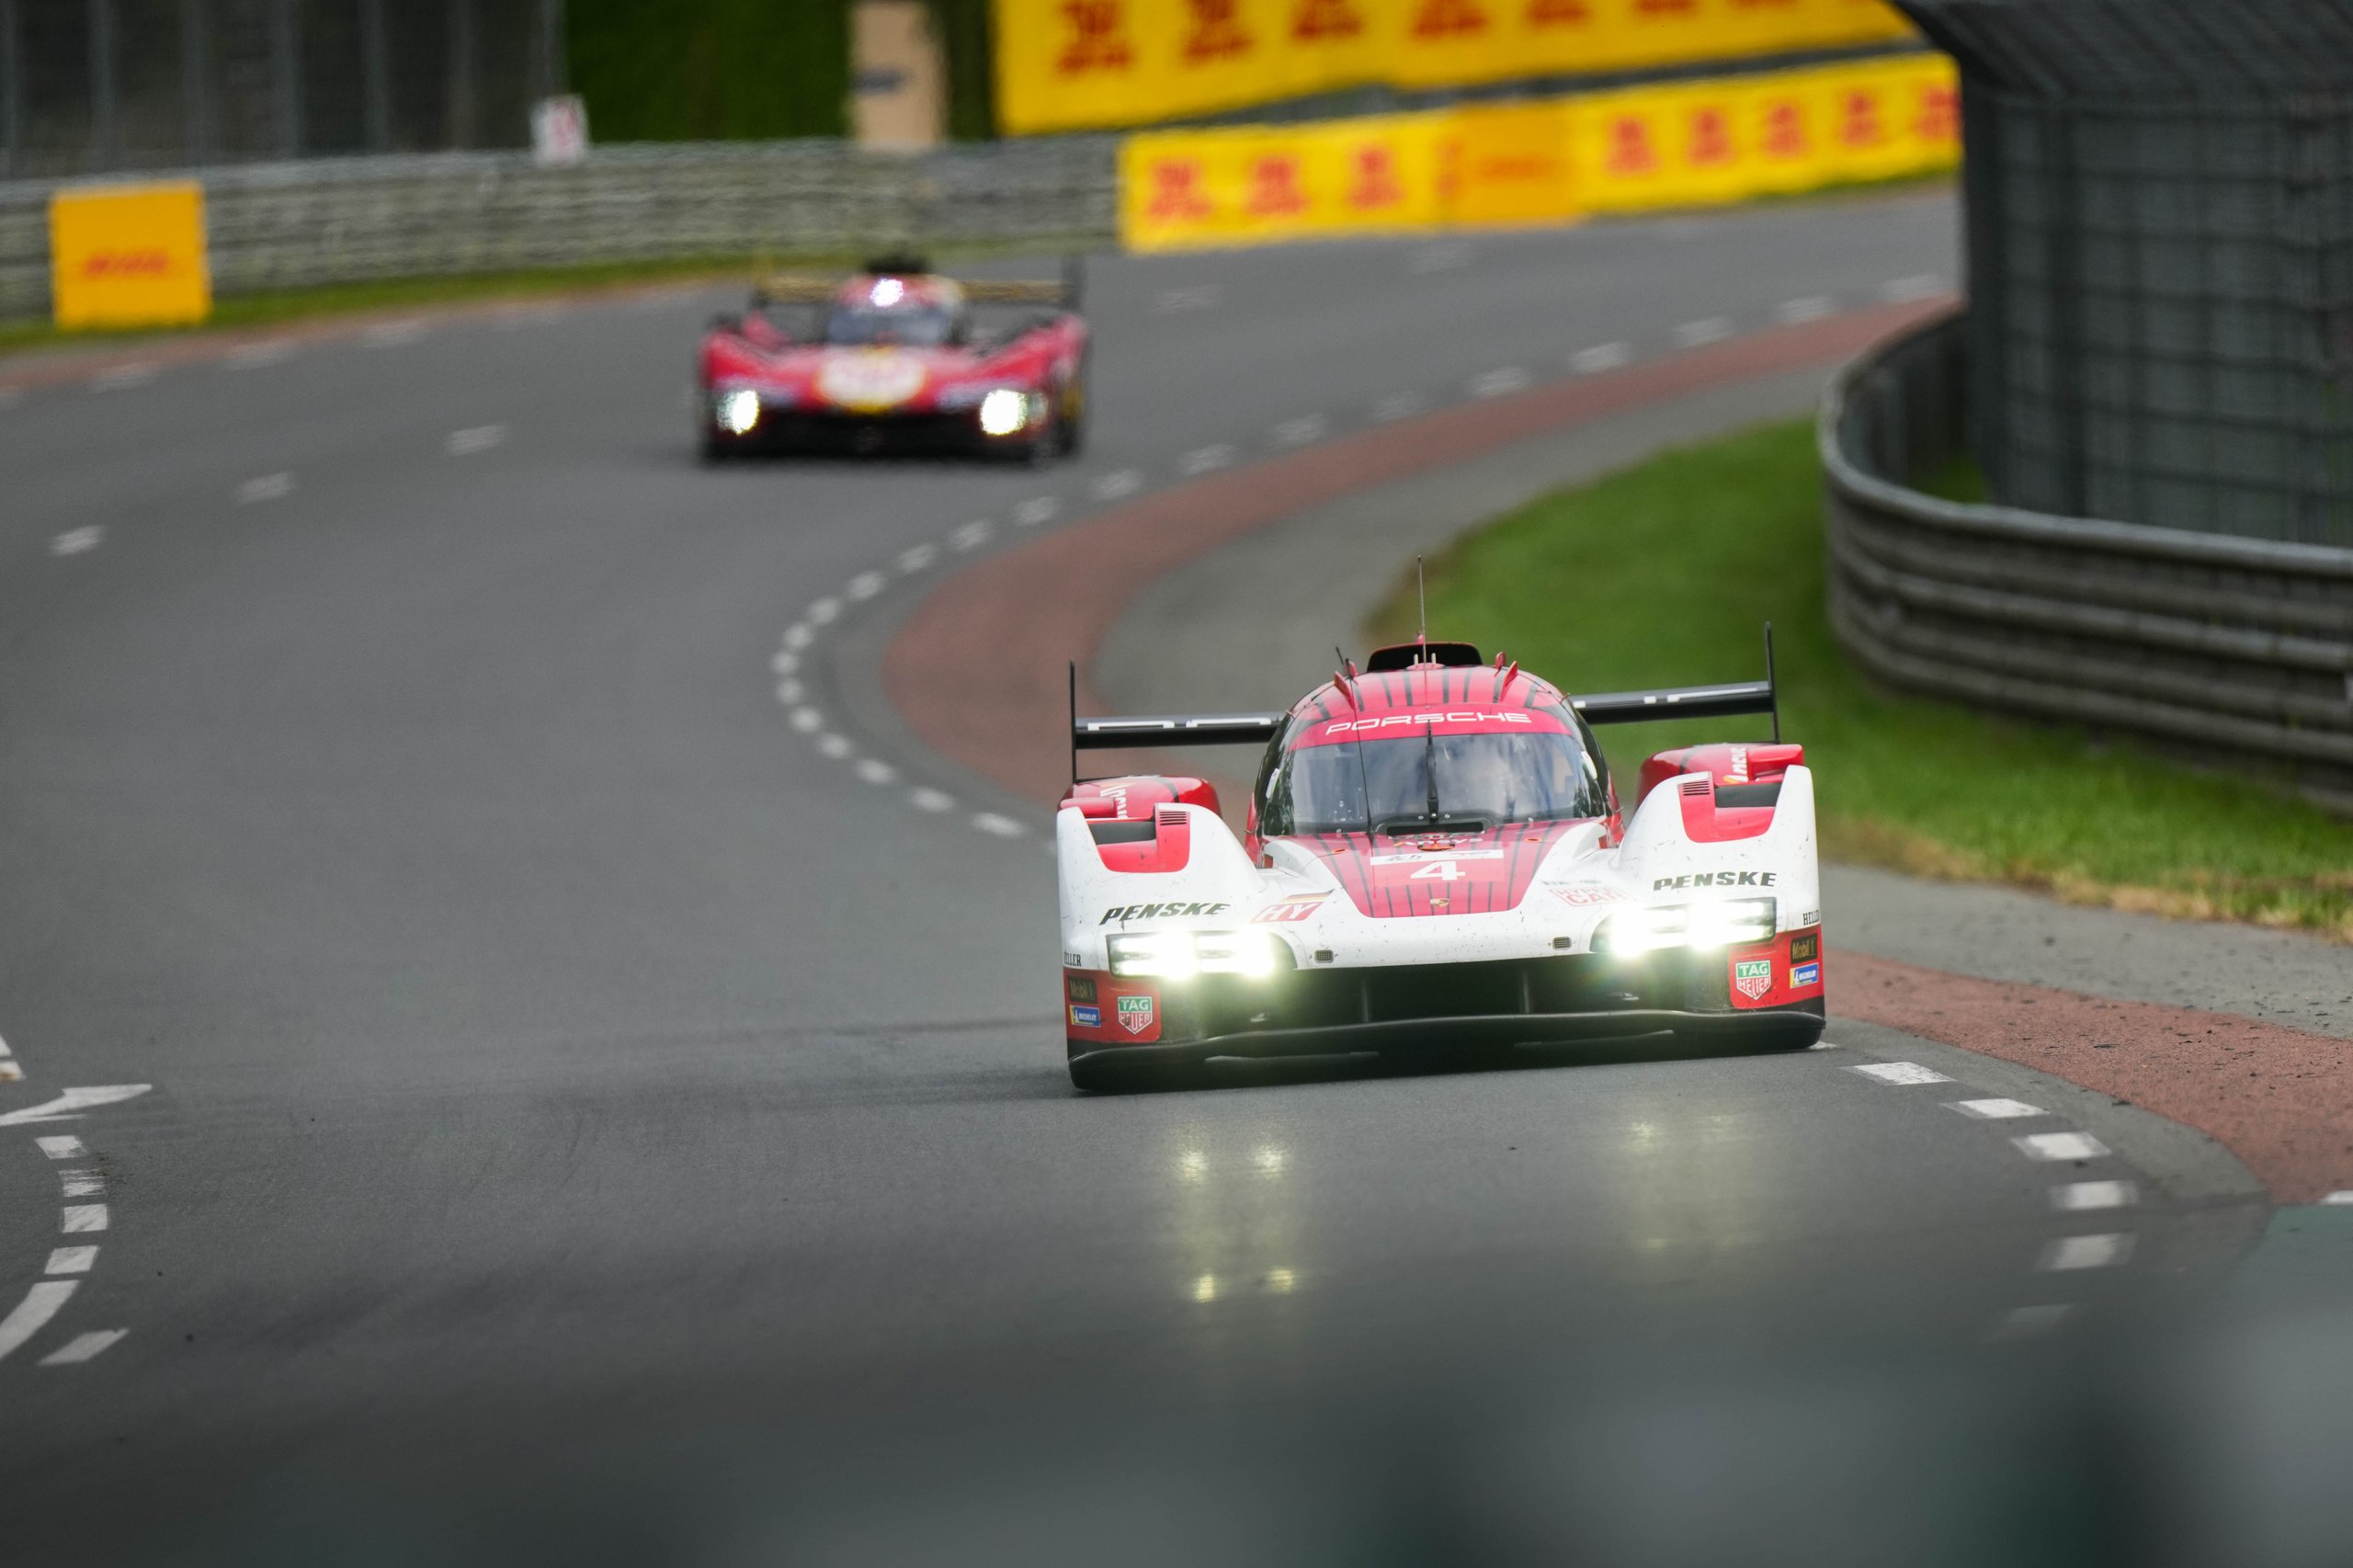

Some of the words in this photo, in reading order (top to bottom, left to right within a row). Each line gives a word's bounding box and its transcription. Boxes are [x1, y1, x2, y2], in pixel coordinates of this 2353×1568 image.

[1325, 712, 1532, 735] PORSCHE
[1411, 861, 1465, 881] 4
[1654, 871, 1777, 891] PENSKE
[1099, 903, 1230, 926] PENSKE
[1739, 962, 1768, 976] TAG
[1739, 979, 1769, 996] HEUER
[1121, 999, 1149, 1011] TAG
[1120, 1013, 1150, 1030] HEUER
